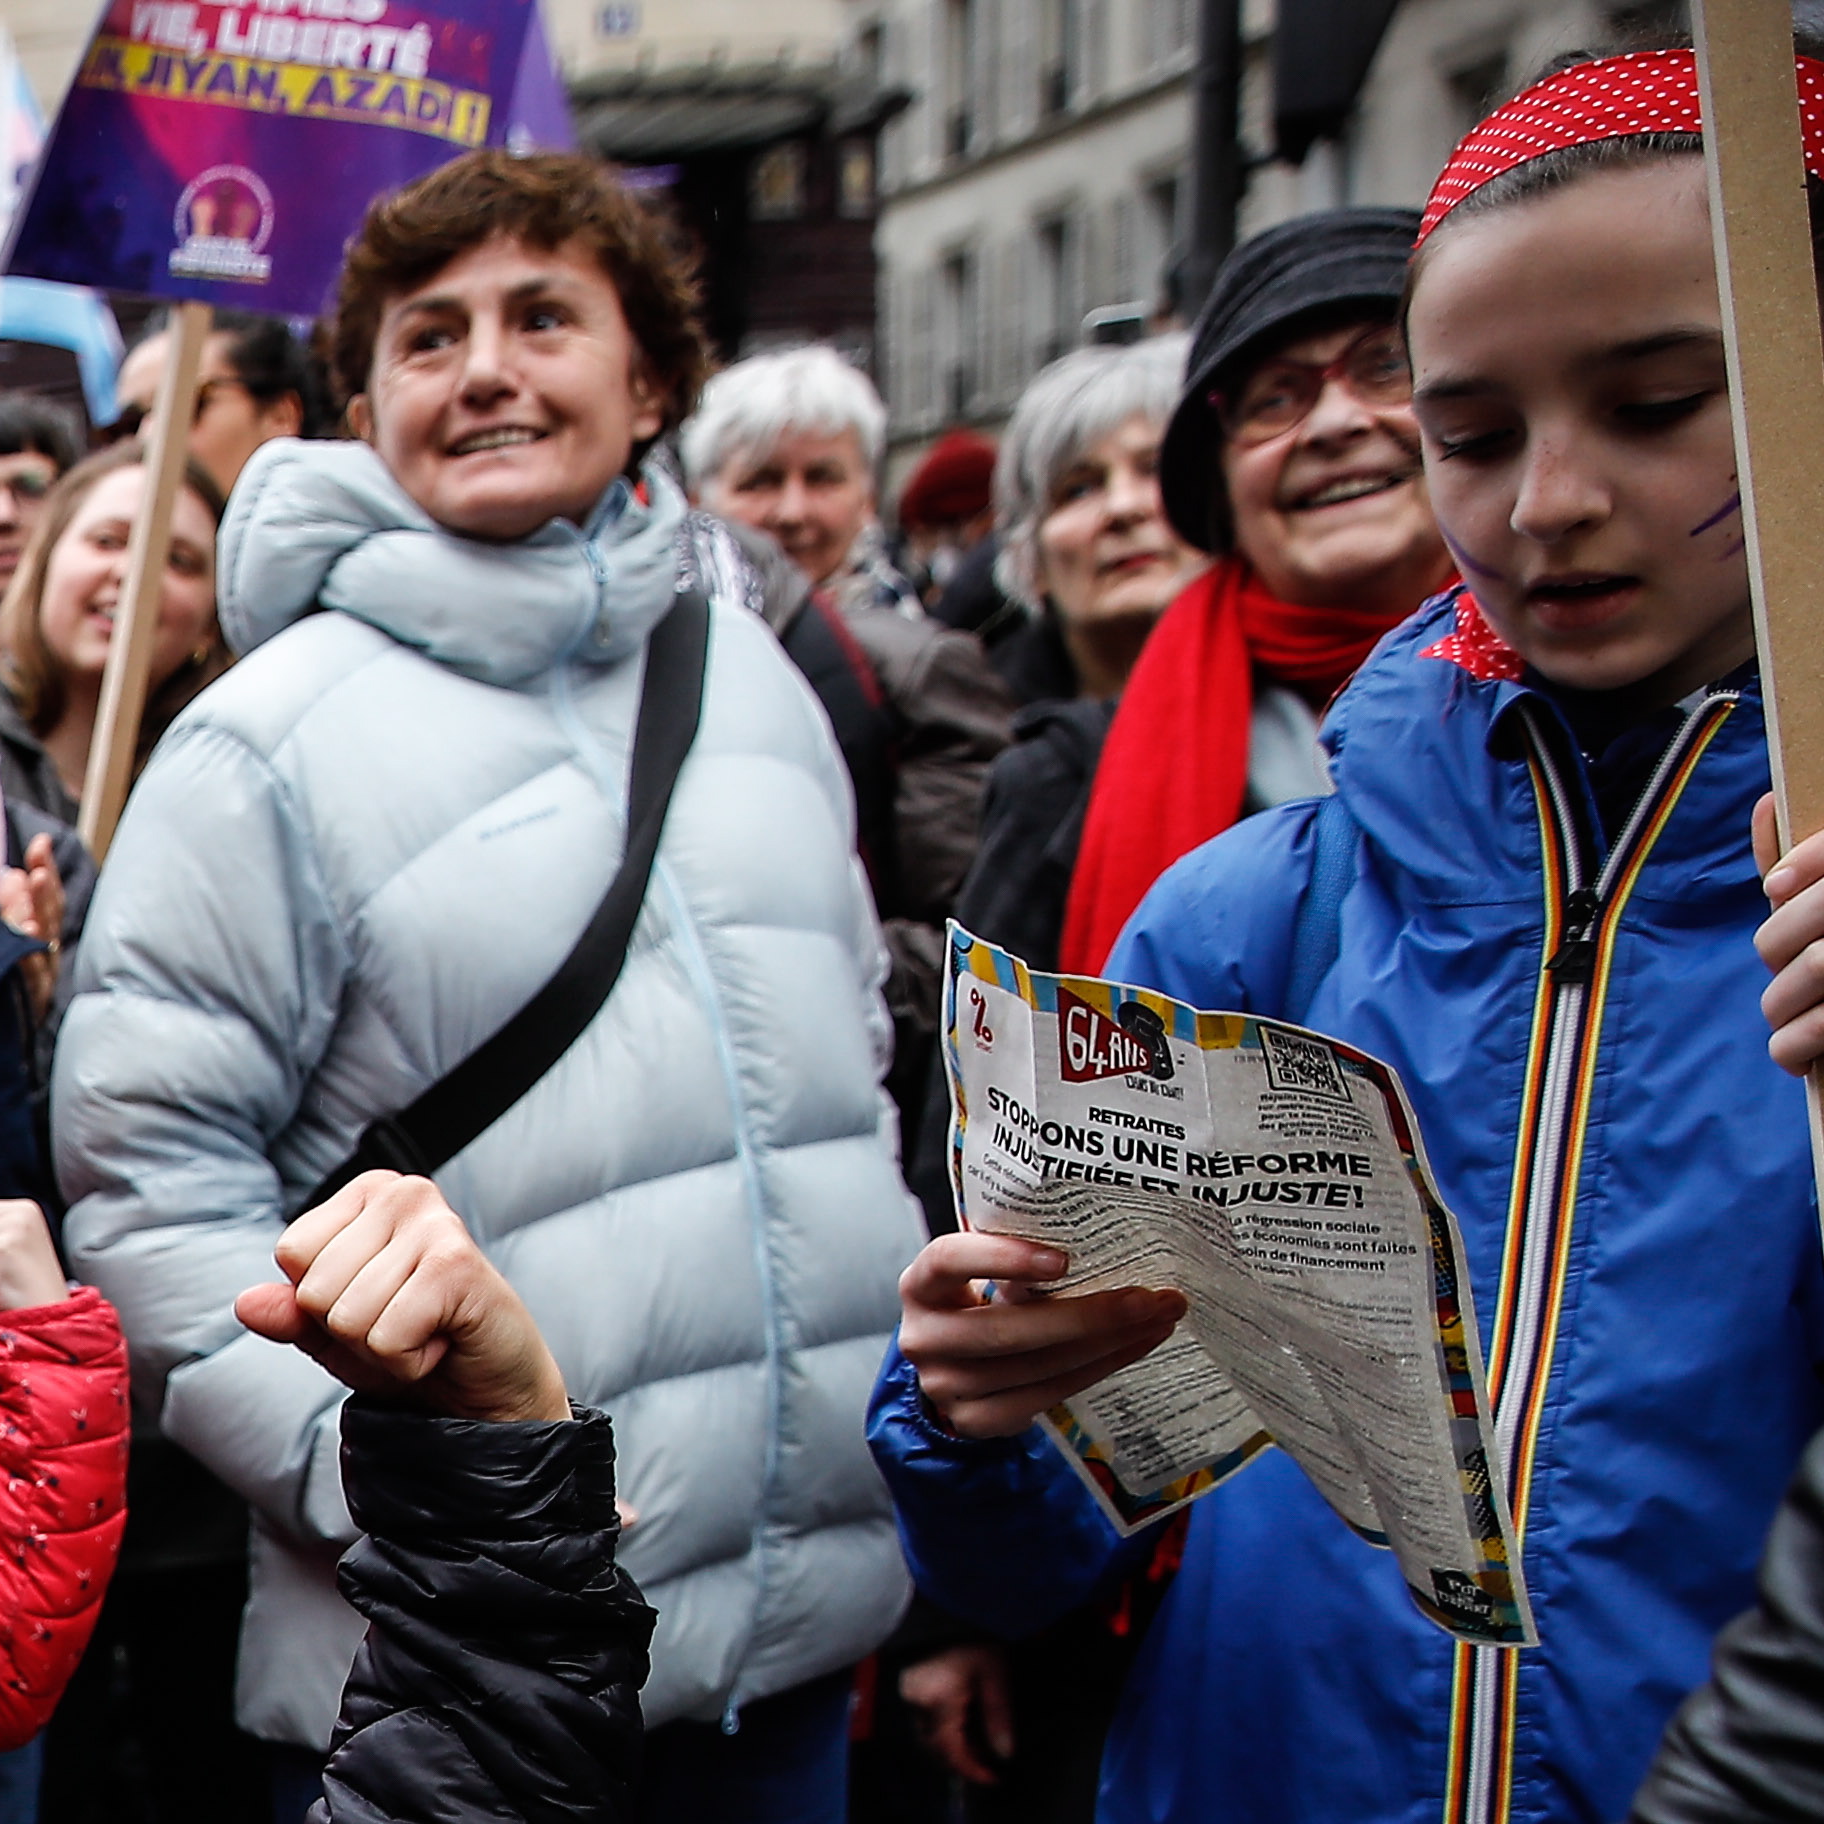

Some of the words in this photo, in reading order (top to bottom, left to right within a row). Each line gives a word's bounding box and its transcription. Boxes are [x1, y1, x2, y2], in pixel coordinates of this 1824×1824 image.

[214, 8, 434, 78] LIBERTÉ
[1066, 1005, 1108, 1076] 64
[1109, 1032, 1148, 1070] ANS
[987, 1087, 1105, 1156] STOPPONS
[1112, 1138, 1180, 1171] UNE
[1186, 1150, 1373, 1179] RÉFORME
[1088, 1106, 1186, 1141] RETRAITES
[1245, 1213, 1322, 1231] régression
[1325, 1218, 1381, 1235] sociale
[1253, 1229, 1331, 1251] économies
[1334, 1240, 1367, 1253] sont
[1372, 1240, 1417, 1256] faites
[1271, 1247, 1288, 1262] de
[1290, 1247, 1386, 1272] financement
